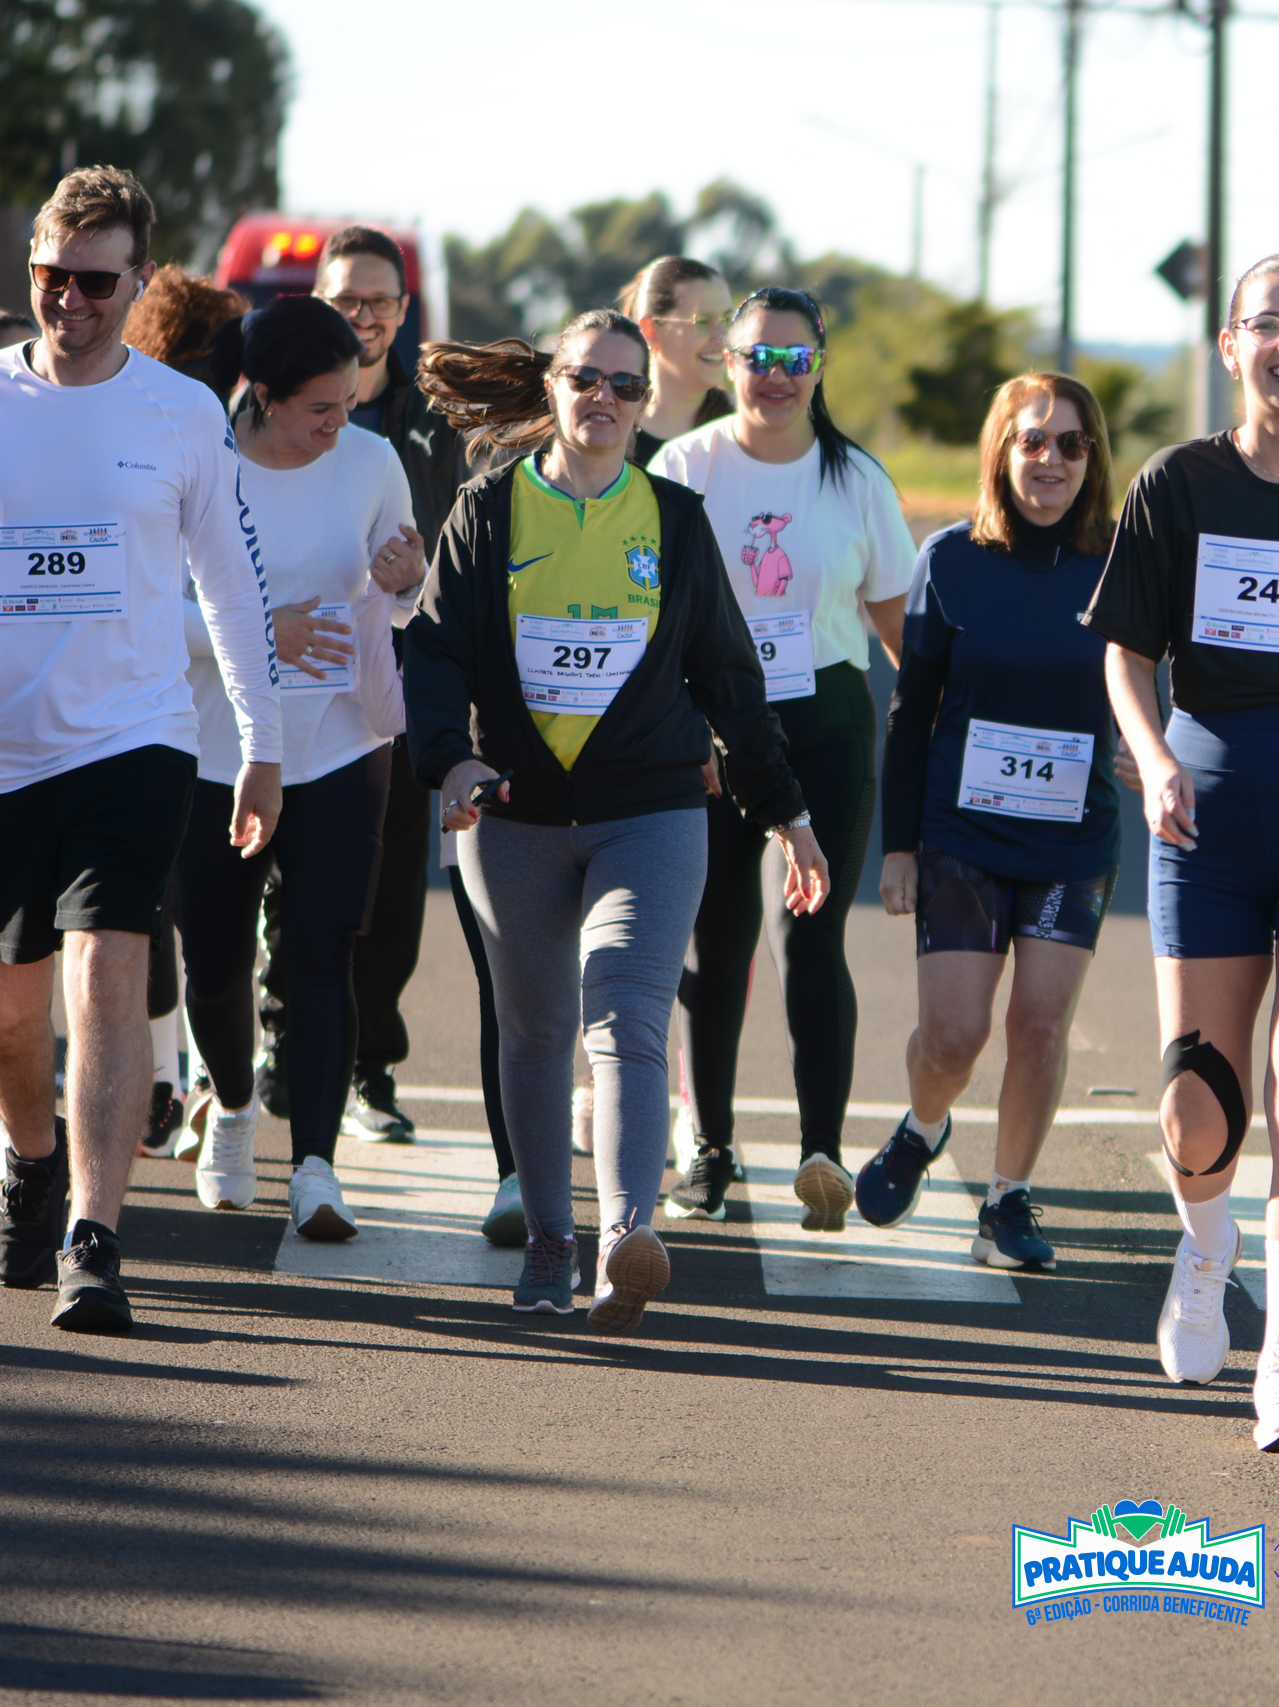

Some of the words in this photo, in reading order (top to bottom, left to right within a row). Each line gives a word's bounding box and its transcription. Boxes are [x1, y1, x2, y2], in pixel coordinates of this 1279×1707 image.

[125, 461, 156, 471] Columbia
[28, 551, 86, 576] 289
[628, 594, 660, 608] BRASI
[552, 645, 612, 669] 297
[1000, 756, 1054, 782] 314
